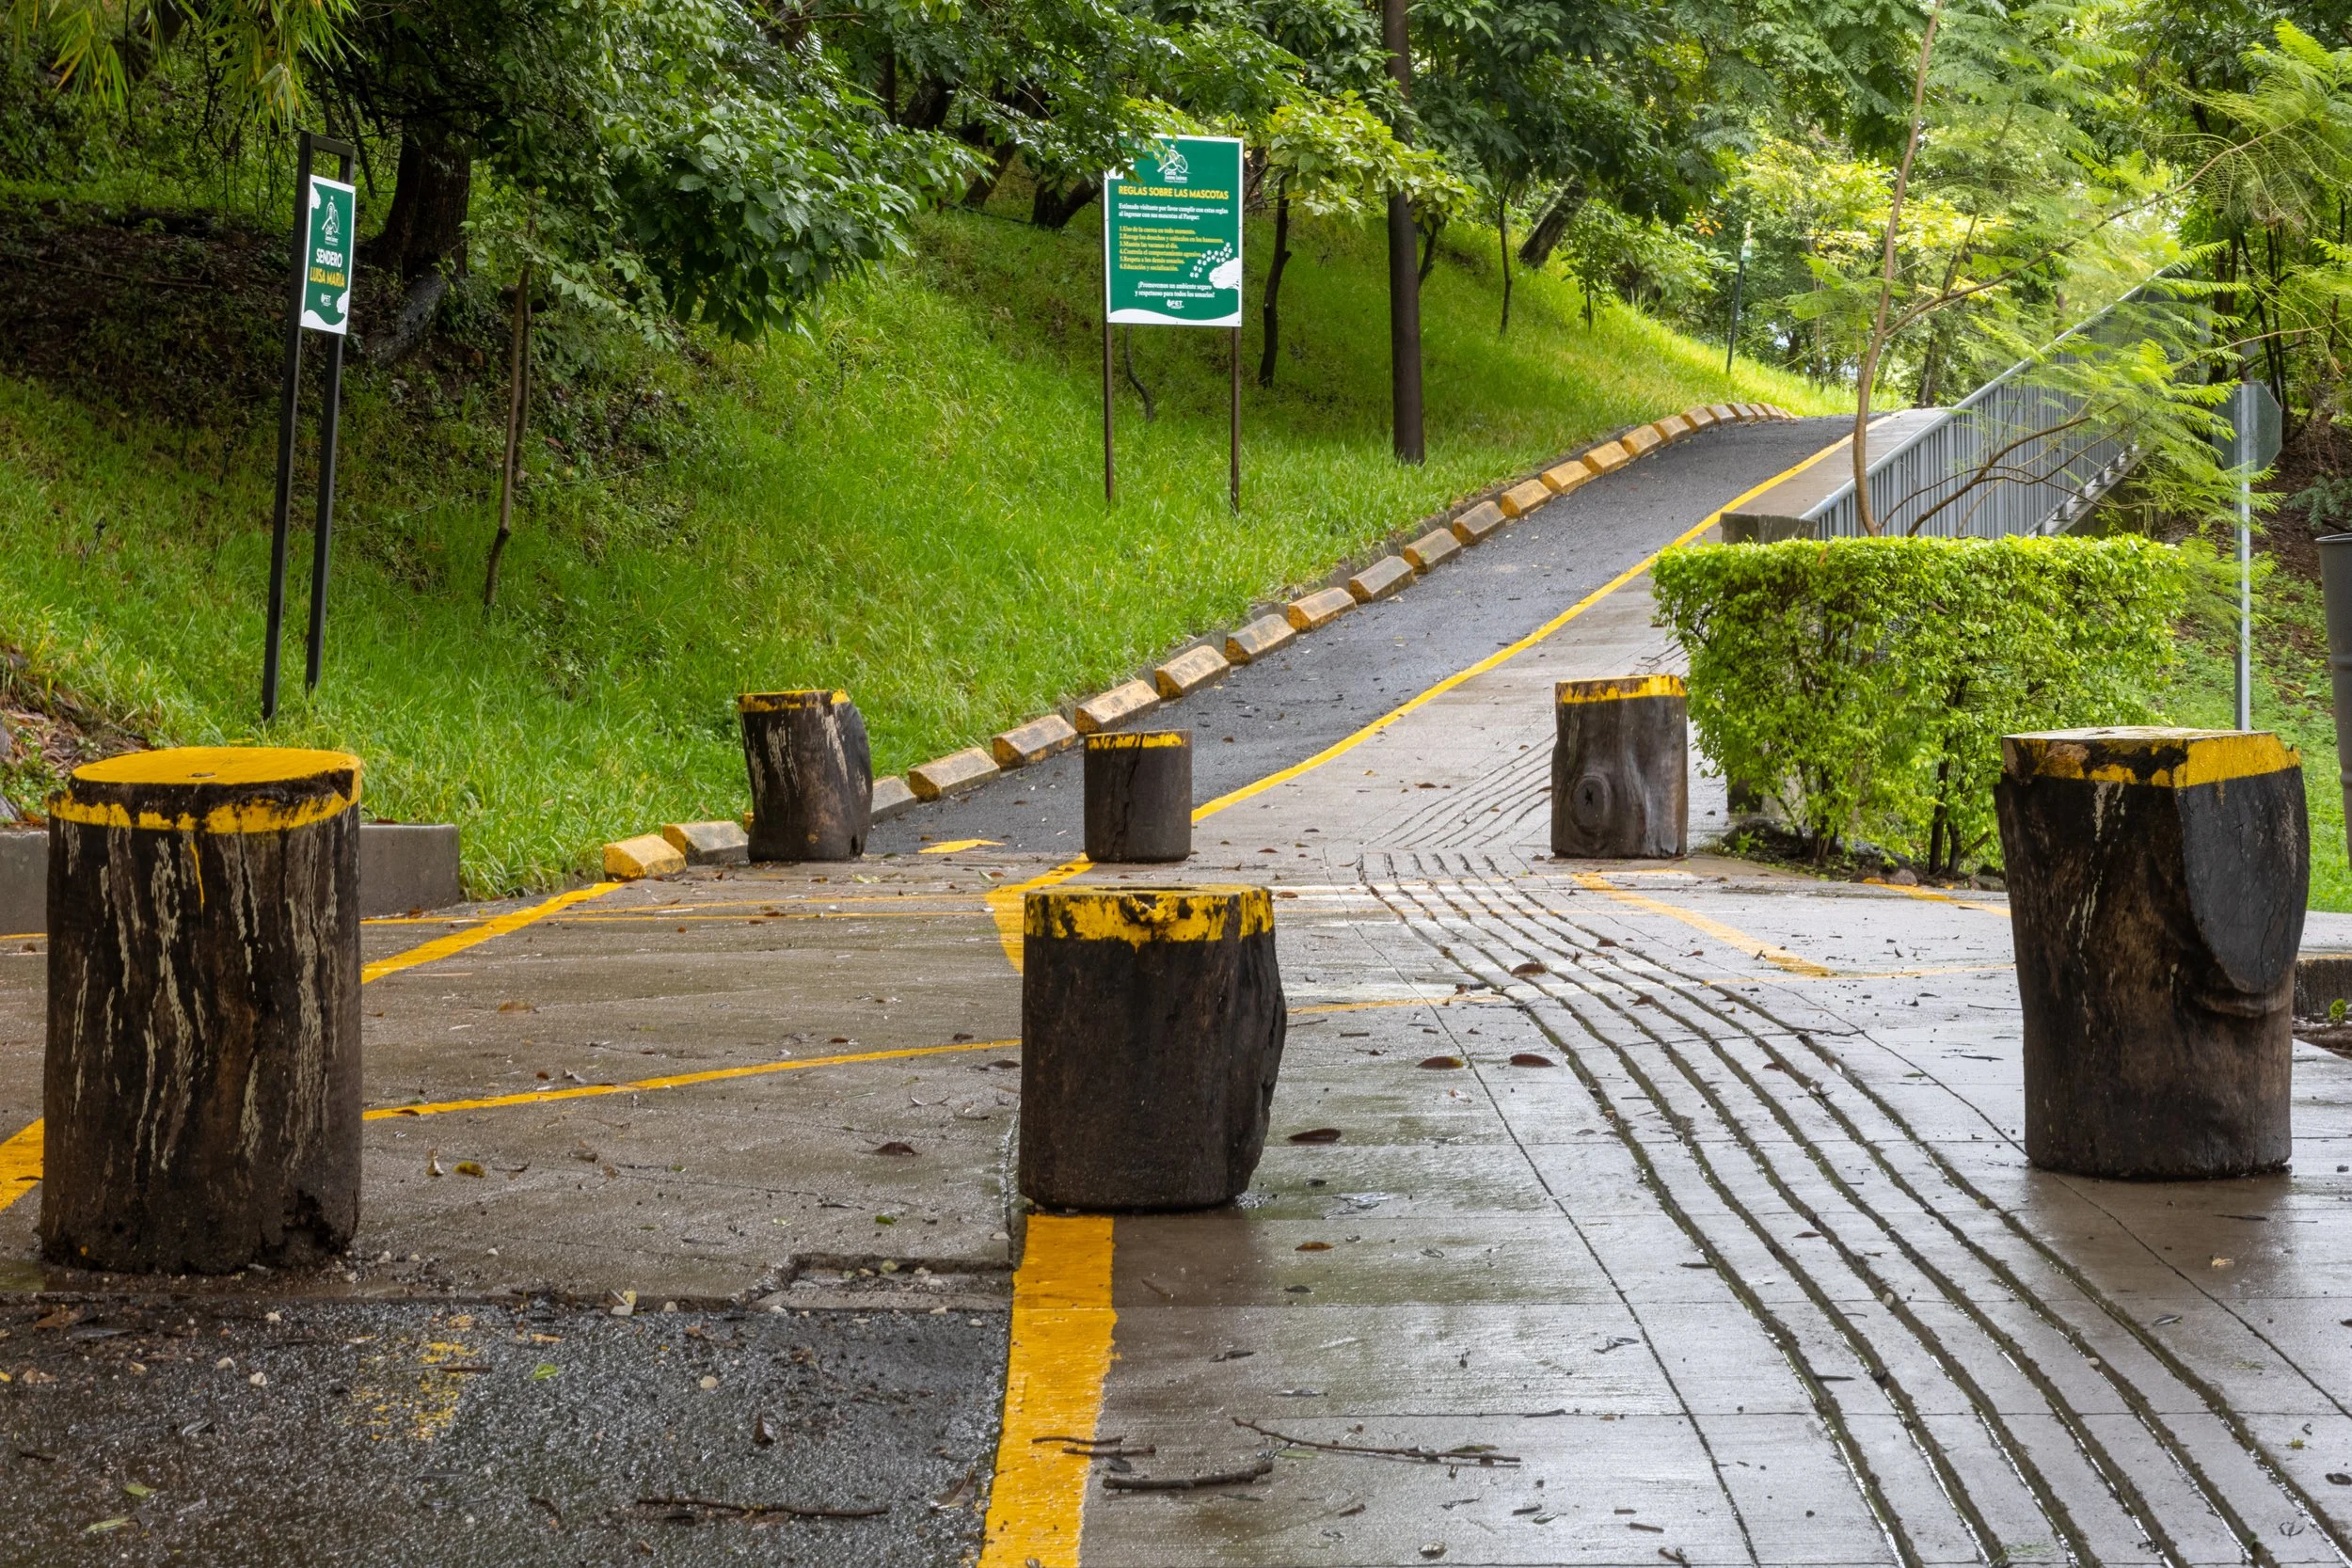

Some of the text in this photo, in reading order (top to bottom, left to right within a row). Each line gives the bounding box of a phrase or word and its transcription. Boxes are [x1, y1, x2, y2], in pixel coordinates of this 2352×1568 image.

[1119, 186, 1229, 199] REGLAS SOBRE LAS MASCOTAS
[316, 248, 342, 267] SENDERO
[310, 266, 345, 287] LUISA MARÍA
